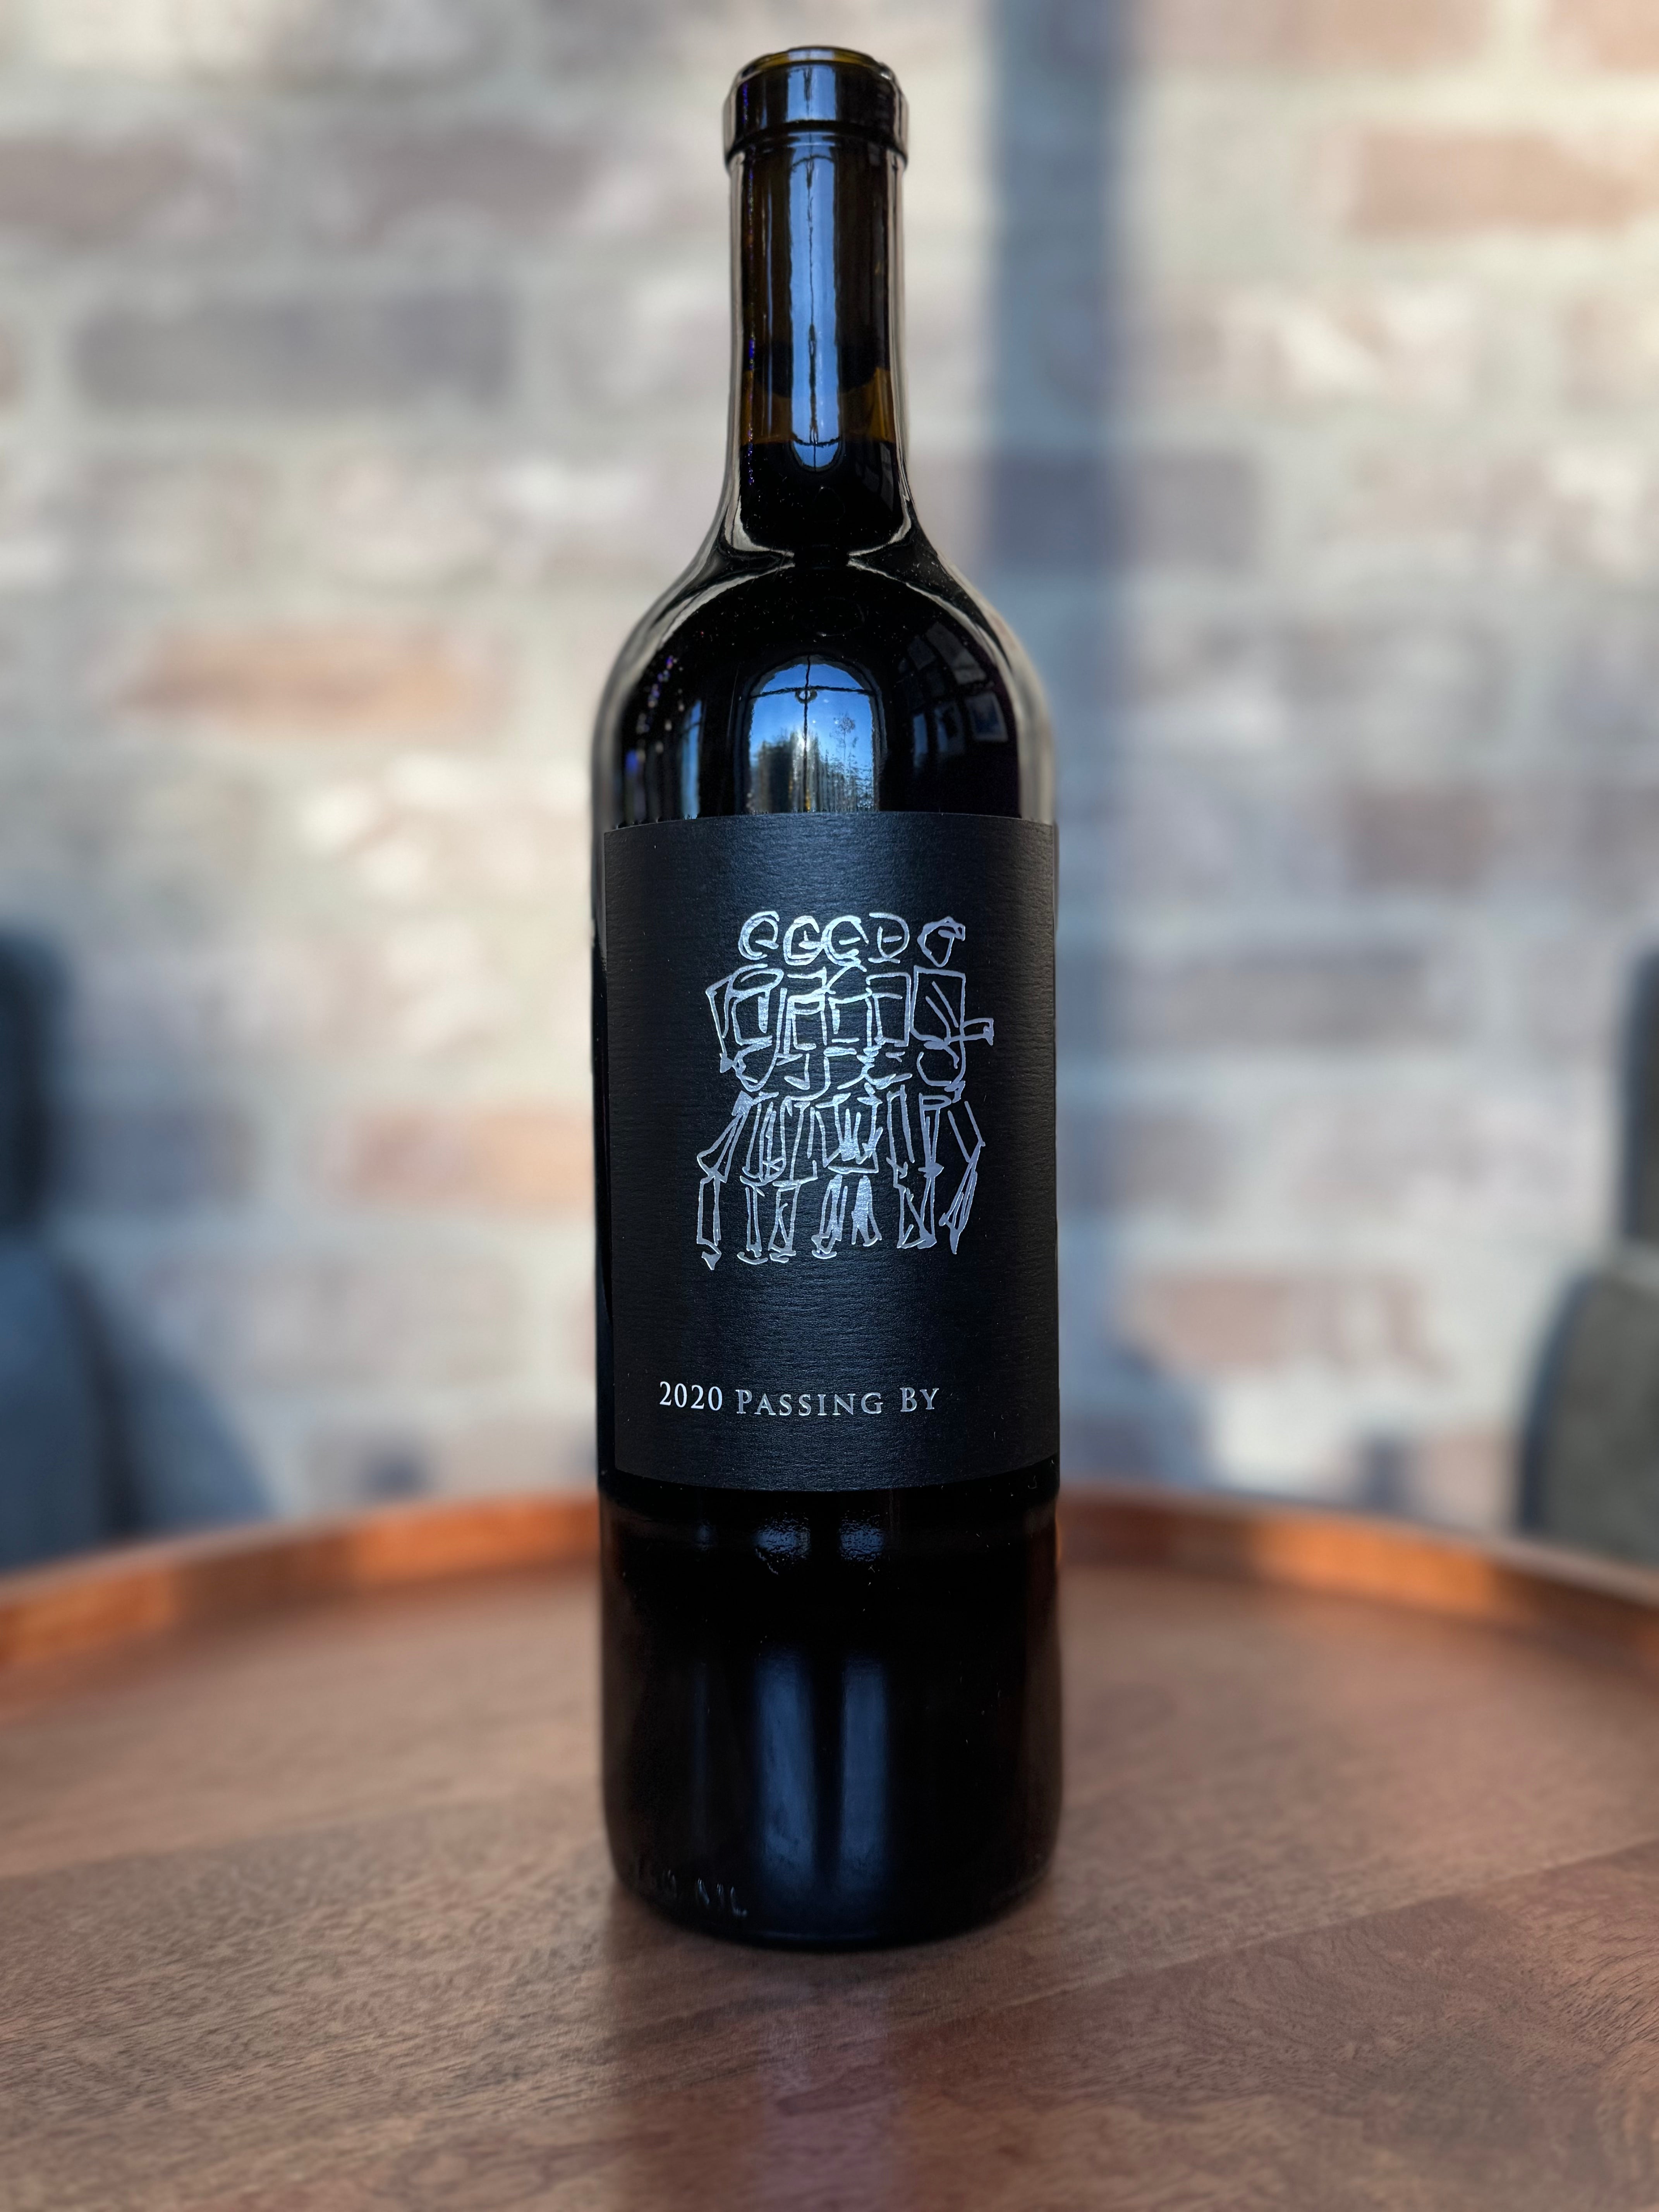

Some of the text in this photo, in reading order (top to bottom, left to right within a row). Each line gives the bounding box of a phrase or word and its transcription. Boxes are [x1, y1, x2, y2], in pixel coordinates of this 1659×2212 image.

[659, 1381, 939, 1416] 2020 PASSING BY
